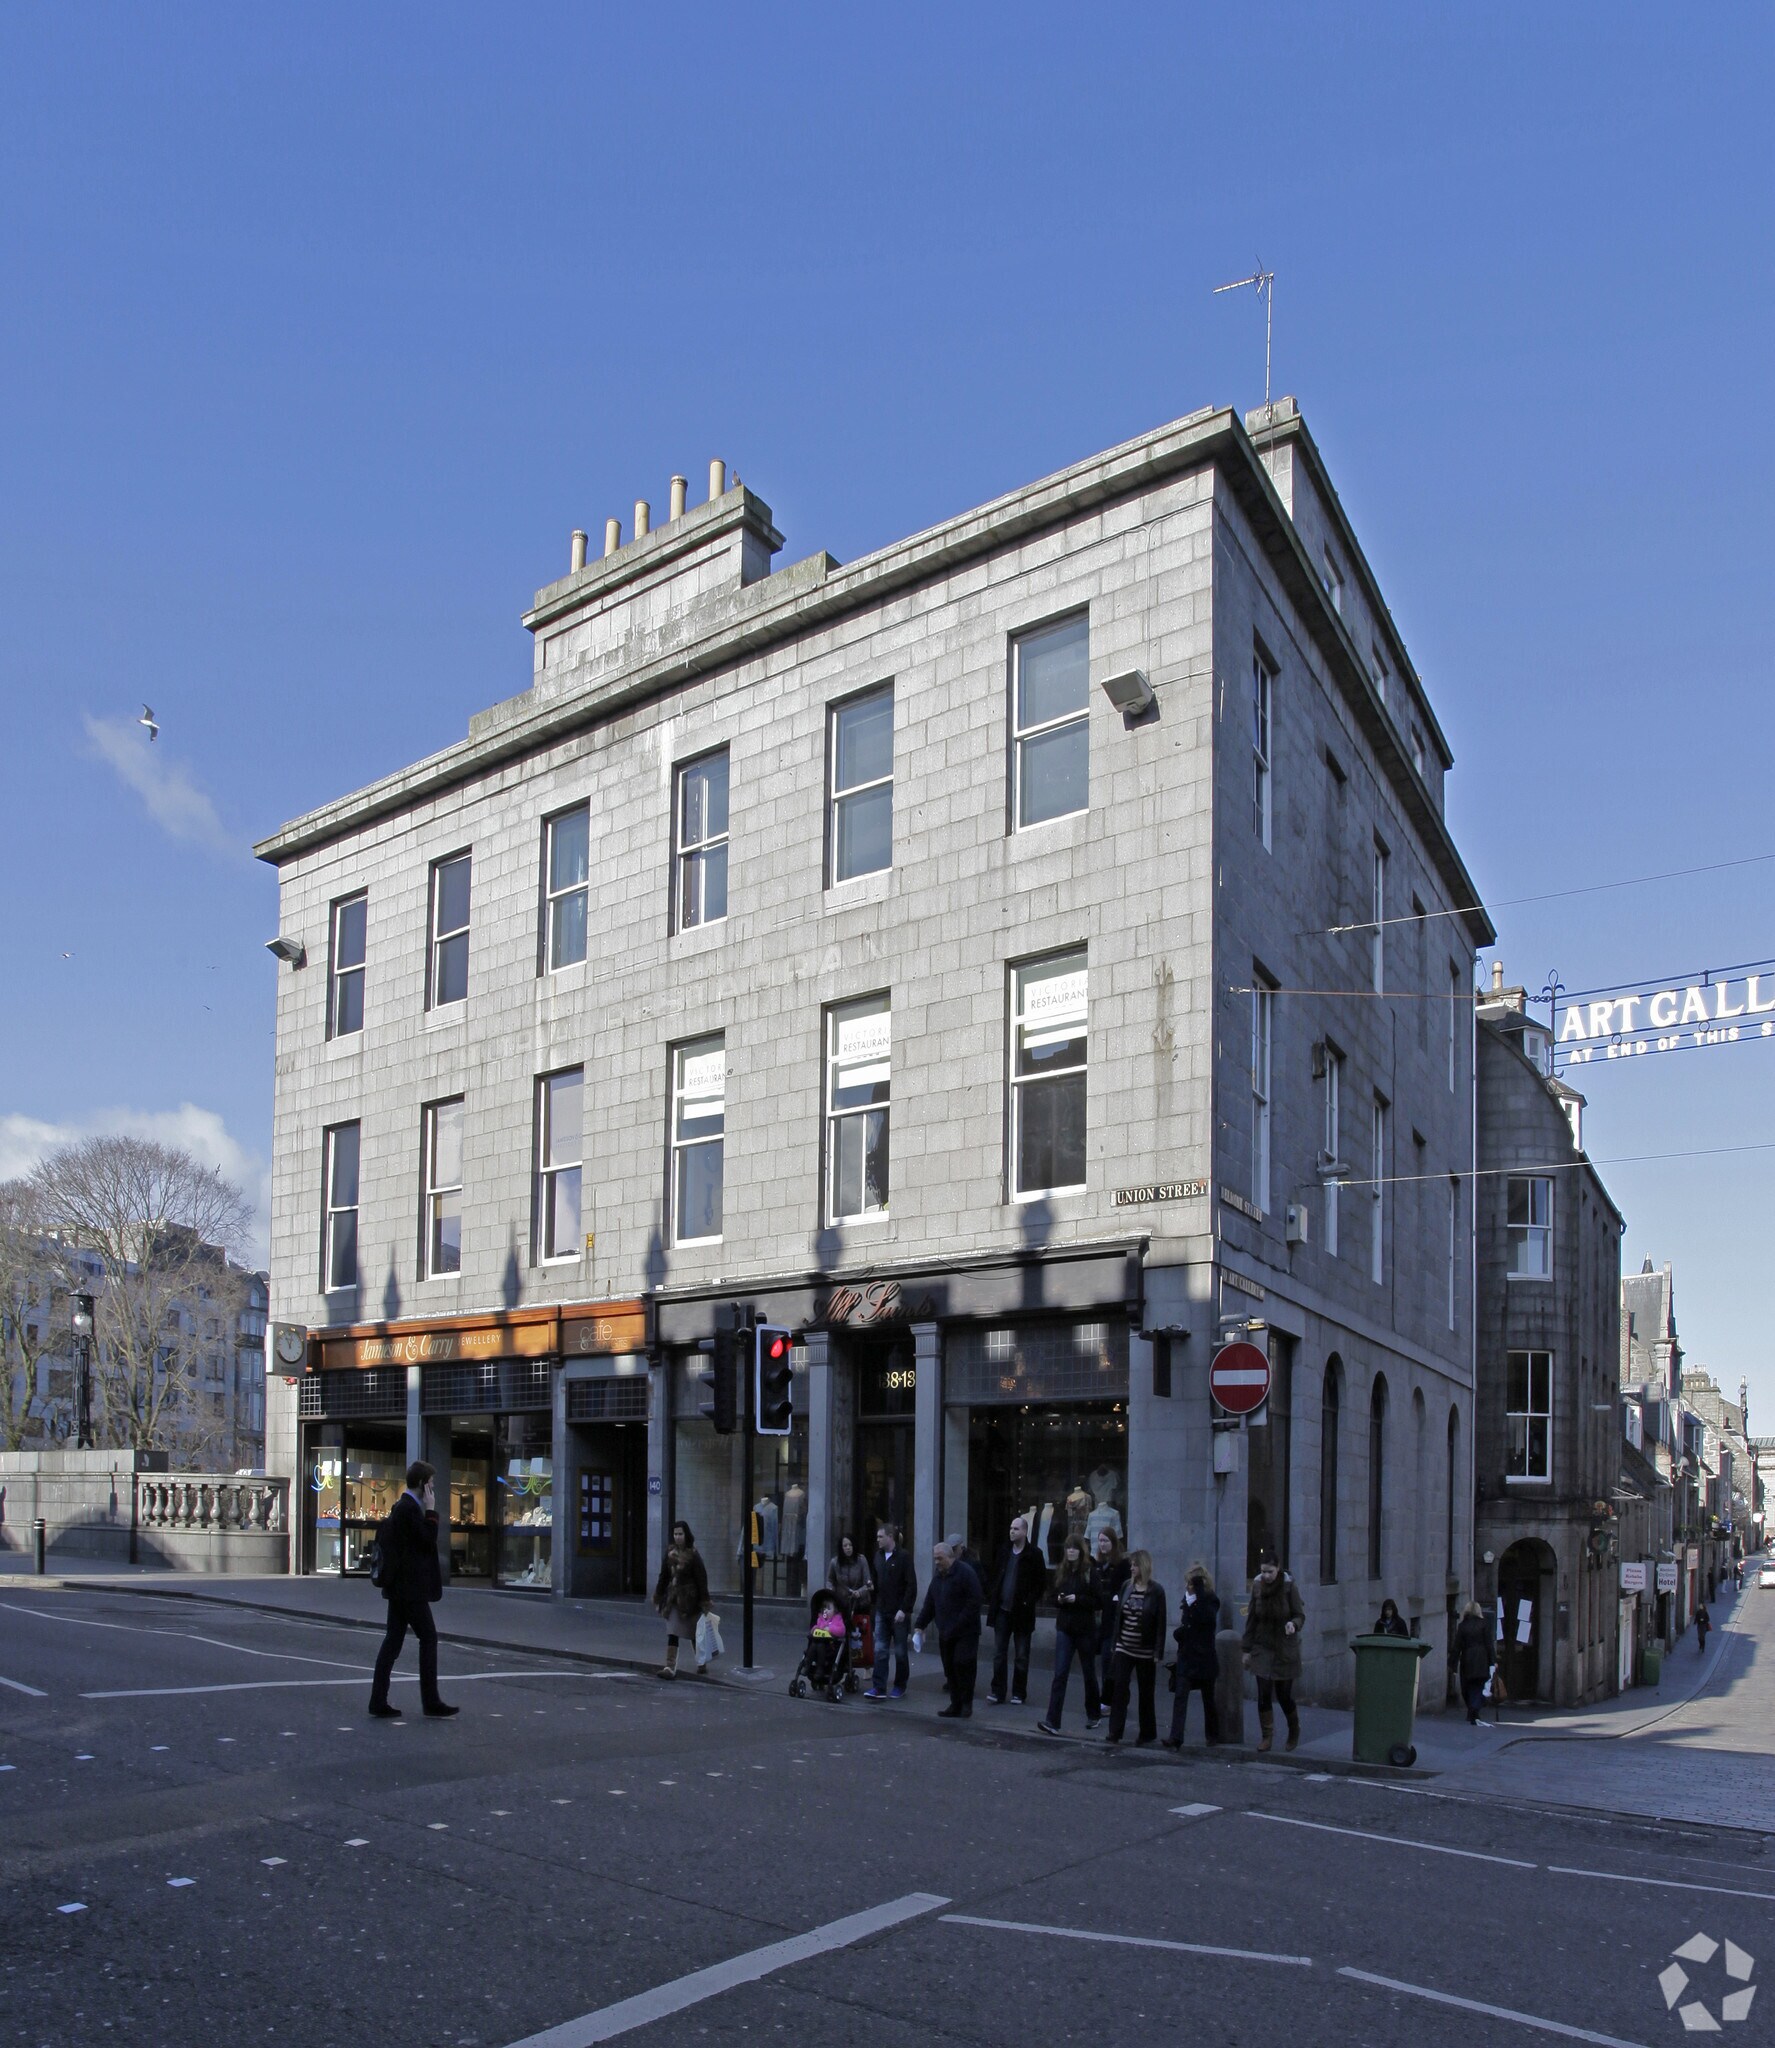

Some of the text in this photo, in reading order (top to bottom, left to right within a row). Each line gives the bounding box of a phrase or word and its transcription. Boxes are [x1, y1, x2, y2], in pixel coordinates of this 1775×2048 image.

[1559, 976, 1775, 1042] ART GALL
[844, 1026, 891, 1041] VICTORI
[844, 1037, 891, 1053] RESTAURAN
[1569, 1048, 1593, 1063] AT
[1607, 1041, 1647, 1059] END
[1658, 1035, 1680, 1051] OF
[1694, 1027, 1739, 1046] THIS
[1117, 1182, 1207, 1204] UNION STREET
[405, 1336, 418, 1361] &
[1658, 1578, 1676, 1586] Hotel
